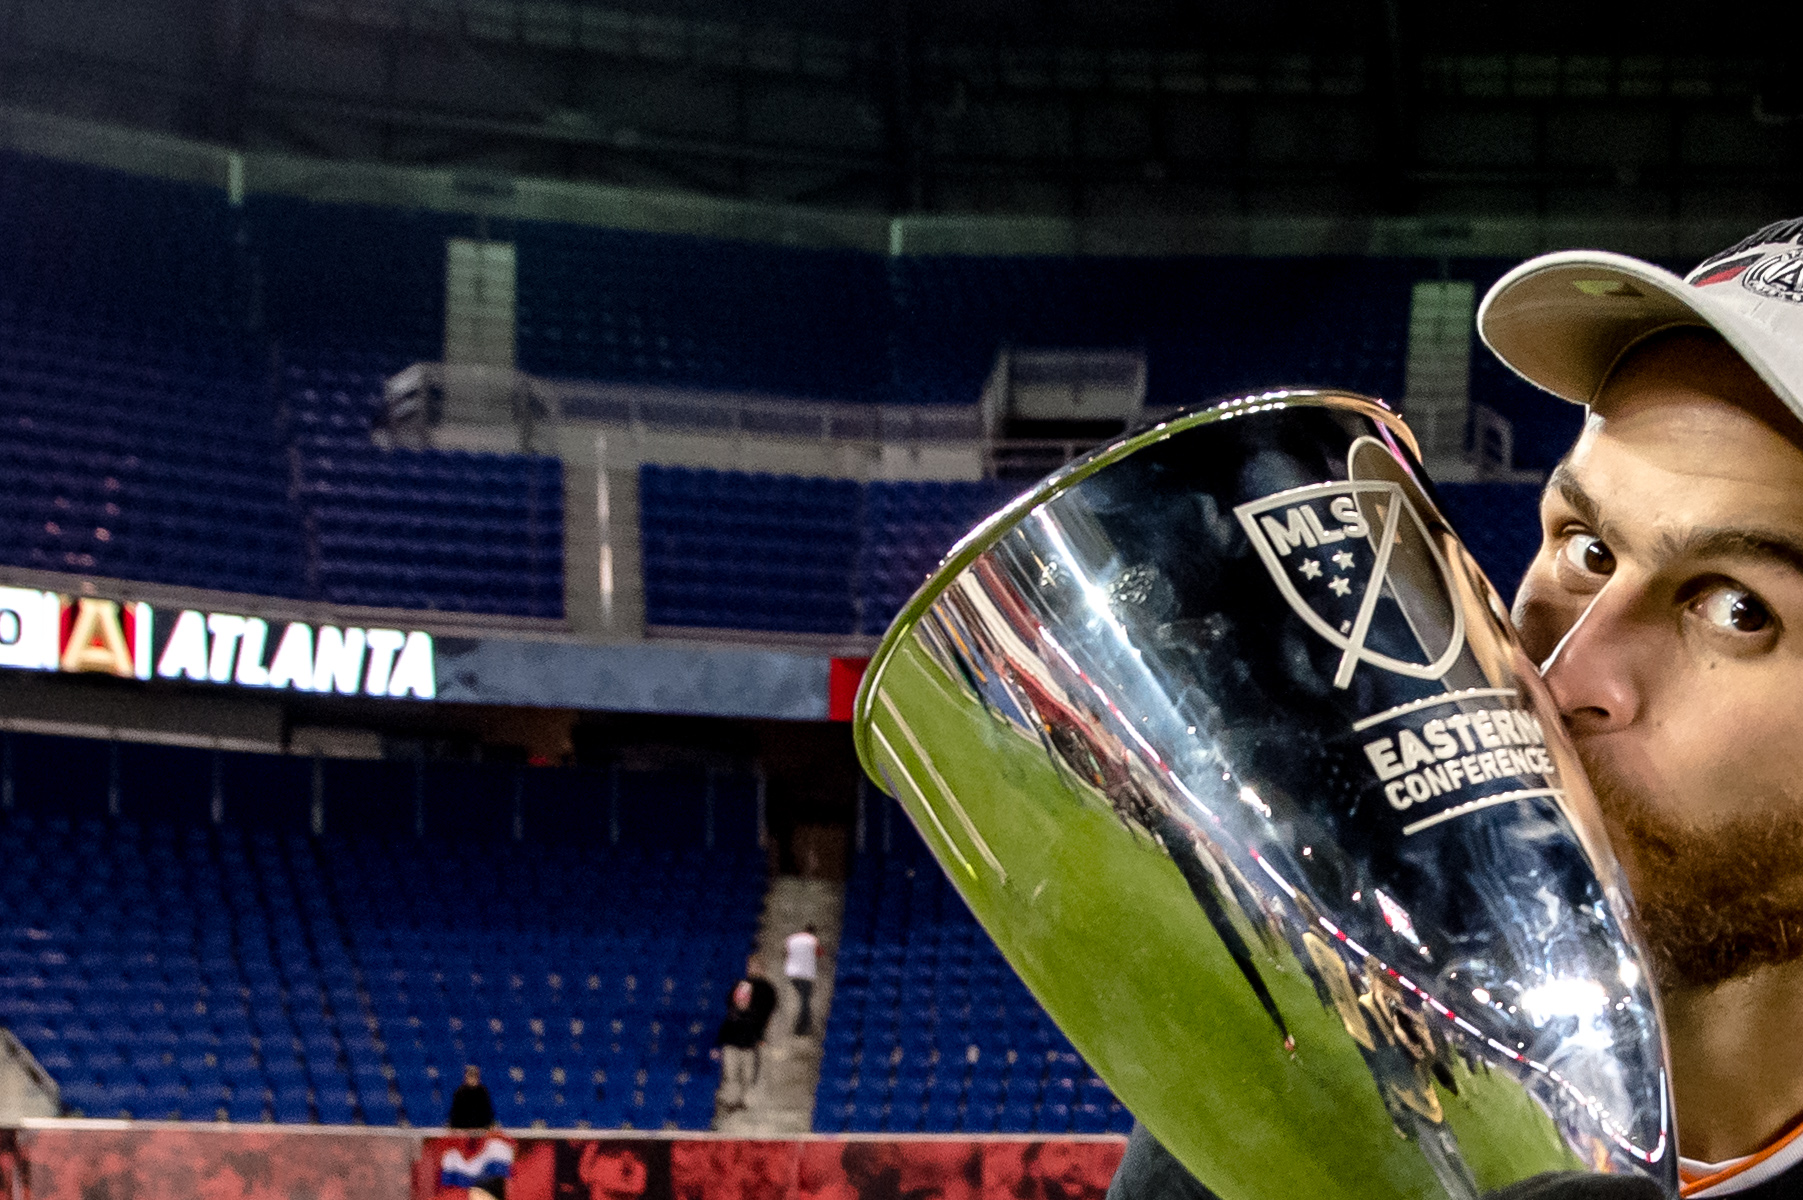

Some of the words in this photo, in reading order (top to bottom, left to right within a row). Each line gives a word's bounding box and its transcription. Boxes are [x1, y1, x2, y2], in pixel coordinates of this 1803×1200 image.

[1261, 497, 1369, 556] MLS
[157, 610, 437, 700] ATLANTA
[1363, 708, 1544, 781] EASTERN
[1384, 746, 1555, 811] CONFERENCE
